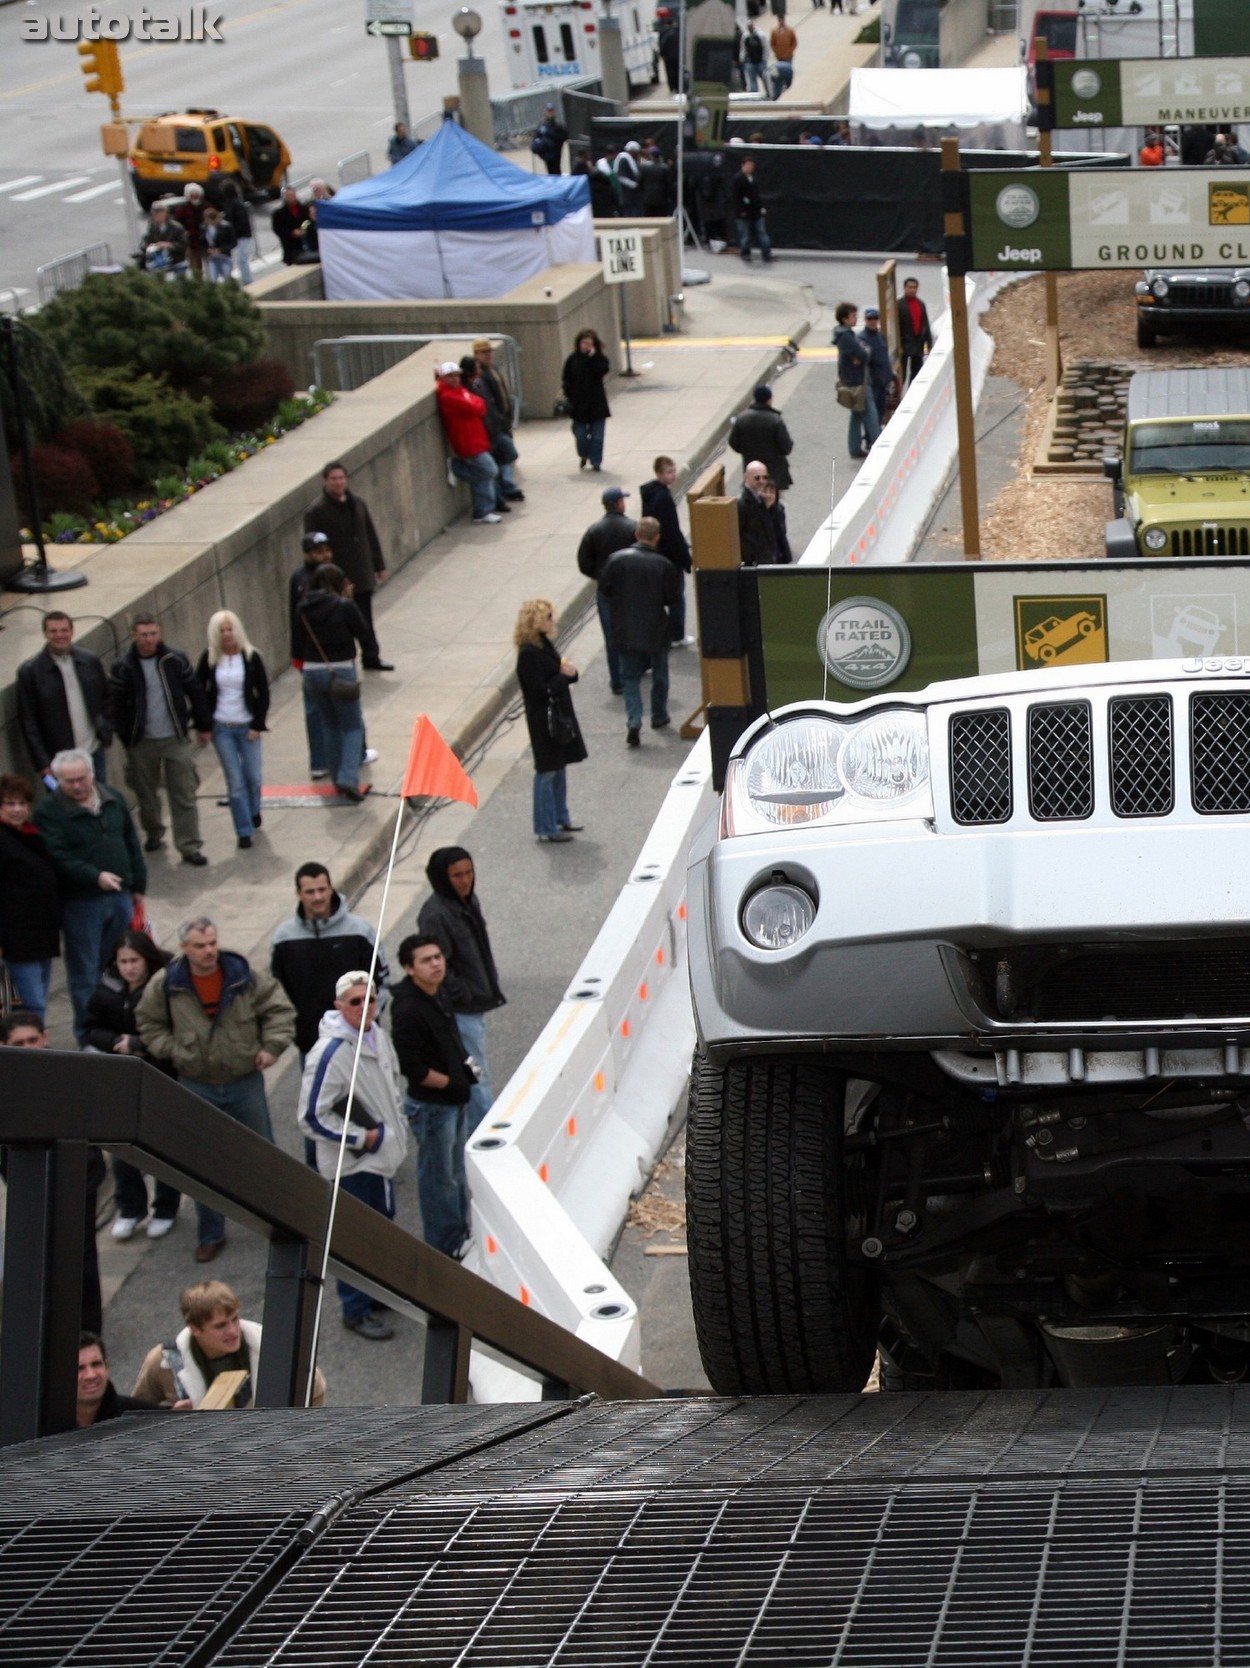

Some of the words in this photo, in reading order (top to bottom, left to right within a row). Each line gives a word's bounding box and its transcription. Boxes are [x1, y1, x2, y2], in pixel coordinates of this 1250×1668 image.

[538, 63, 580, 77] POLICE
[1072, 110, 1103, 123] Jeep
[608, 236, 636, 254] TAXI
[1099, 244, 1204, 260] GROUND
[998, 245, 1042, 263] Jeep
[610, 256, 636, 274] LINE
[837, 620, 890, 630] TRAIL
[835, 631, 892, 641] RATED
[844, 663, 887, 671] 4x4
